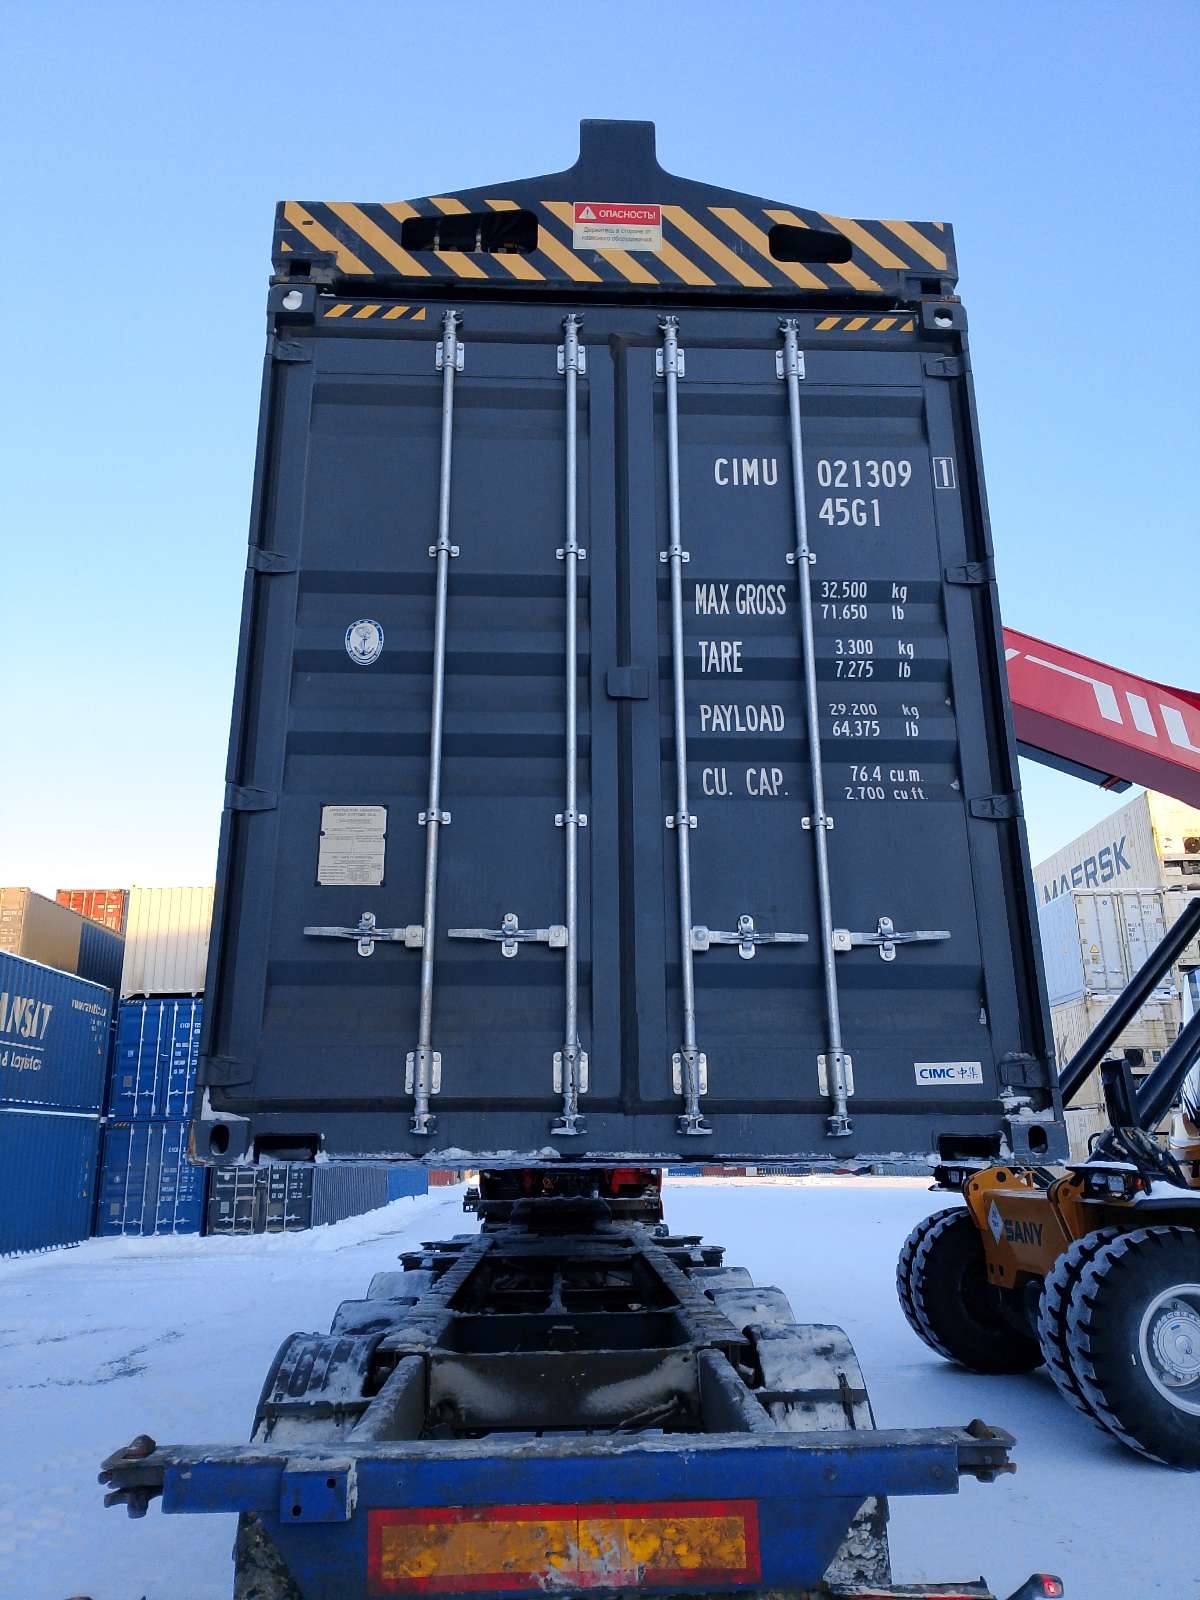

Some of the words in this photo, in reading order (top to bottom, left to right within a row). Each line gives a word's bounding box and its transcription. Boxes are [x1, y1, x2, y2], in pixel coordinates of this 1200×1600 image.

[598, 208, 656, 219] ОПАСНОСТЬ!
[714, 458, 778, 485] CIMU
[816, 460, 912, 488] 021309
[818, 498, 881, 526] 45G1
[695, 584, 729, 615] MAX
[735, 584, 786, 615] GROSS
[821, 581, 867, 598] 32.500
[892, 582, 907, 603] kg
[821, 604, 868, 619] 71.650
[892, 604, 905, 619] lb
[699, 641, 743, 673] TARE
[835, 640, 873, 655] 3.300
[898, 640, 914, 659] kg
[835, 661, 874, 678] 7.275
[898, 661, 911, 678] lb
[700, 704, 785, 732] PAYLOAD
[829, 703, 878, 716] 29.200
[902, 704, 920, 719] kg
[832, 721, 881, 737] 64.375
[905, 721, 919, 737] lb
[702, 768, 733, 796] CU.
[746, 768, 789, 796] CAP.
[850, 766, 882, 782] 76.4
[844, 787, 885, 800] 2.700
[919, 1068, 956, 1079] CIMC
[1003, 1219, 1042, 1246] SANY
